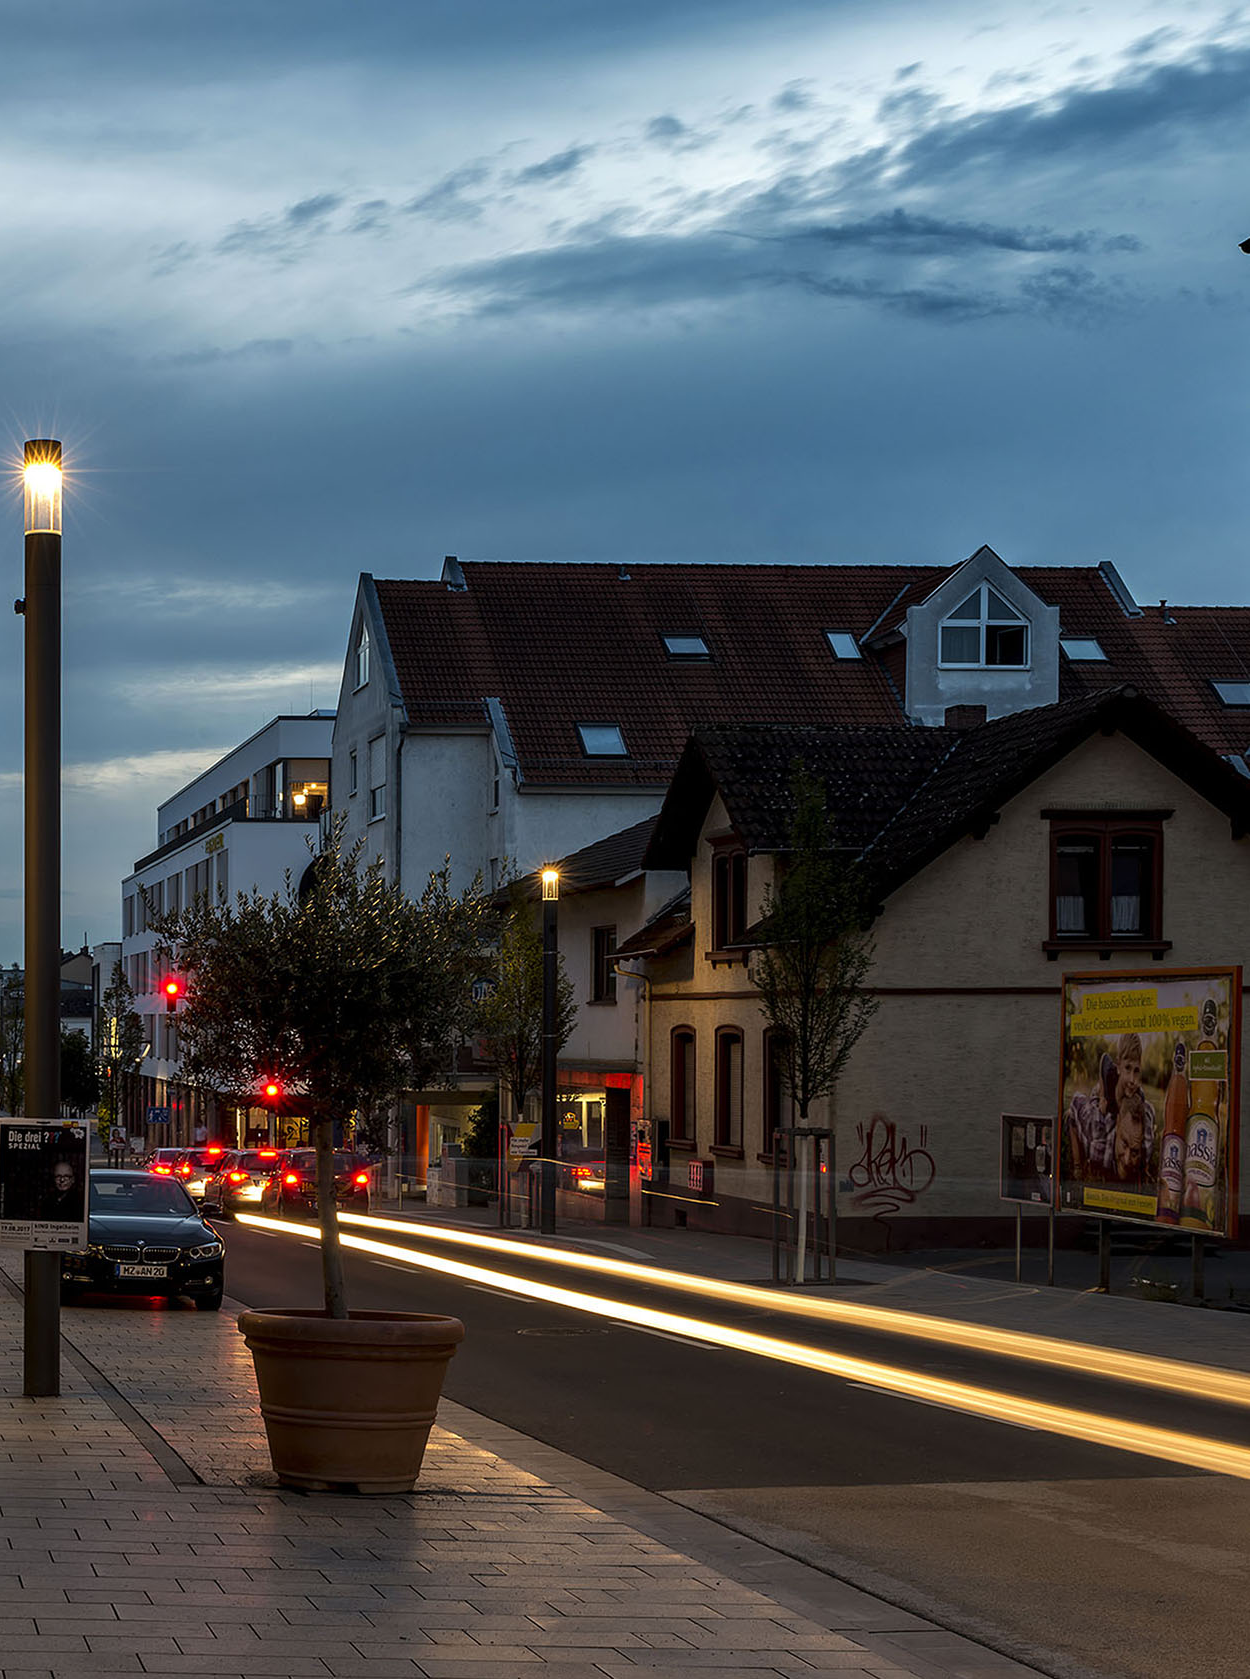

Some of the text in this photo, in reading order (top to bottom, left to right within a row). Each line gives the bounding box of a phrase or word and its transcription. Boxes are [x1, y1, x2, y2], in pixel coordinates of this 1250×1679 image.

[1086, 997, 1097, 1010] Die
[1074, 1018, 1093, 1031] voller
[1094, 1016, 1131, 1030] Geschmack
[1132, 1015, 1146, 1029] und
[8, 1130, 22, 1142] Die
[25, 1131, 42, 1143] drei
[153, 1267, 165, 1276] 20
